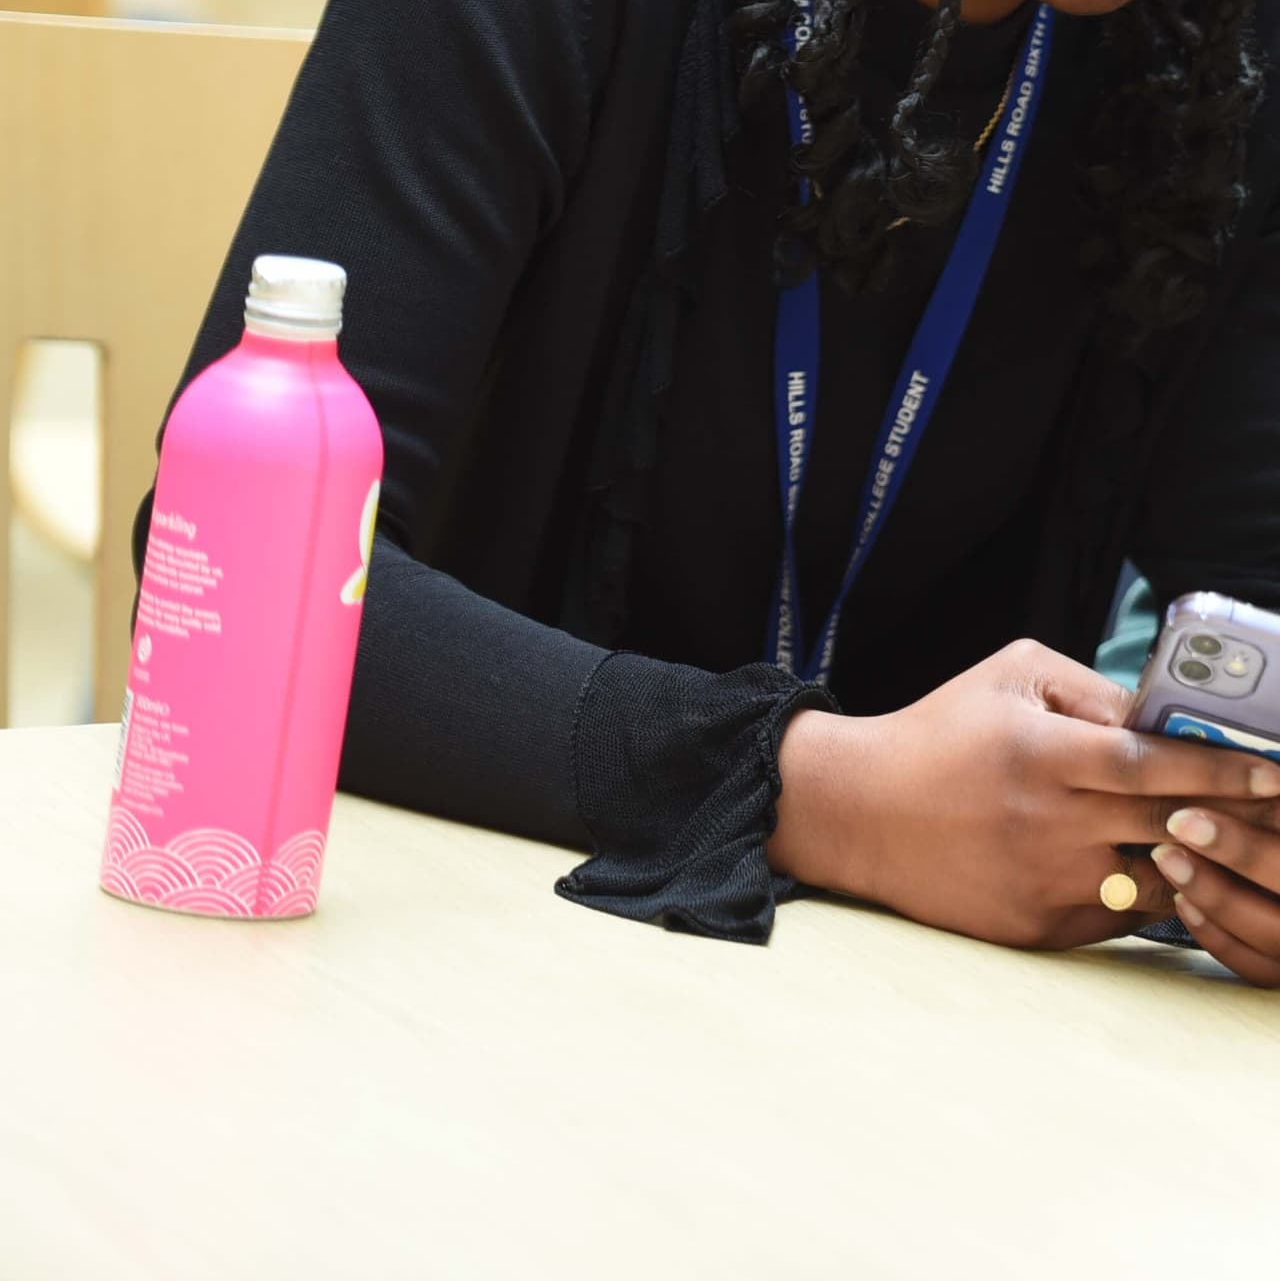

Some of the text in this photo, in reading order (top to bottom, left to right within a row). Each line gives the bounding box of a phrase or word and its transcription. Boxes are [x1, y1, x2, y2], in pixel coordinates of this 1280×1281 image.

[987, 22, 1046, 194] HILLS ROAD SIXTH
[787, 371, 806, 425] HILLS
[884, 370, 930, 458] STUDENT
[788, 428, 805, 482] ROAD
